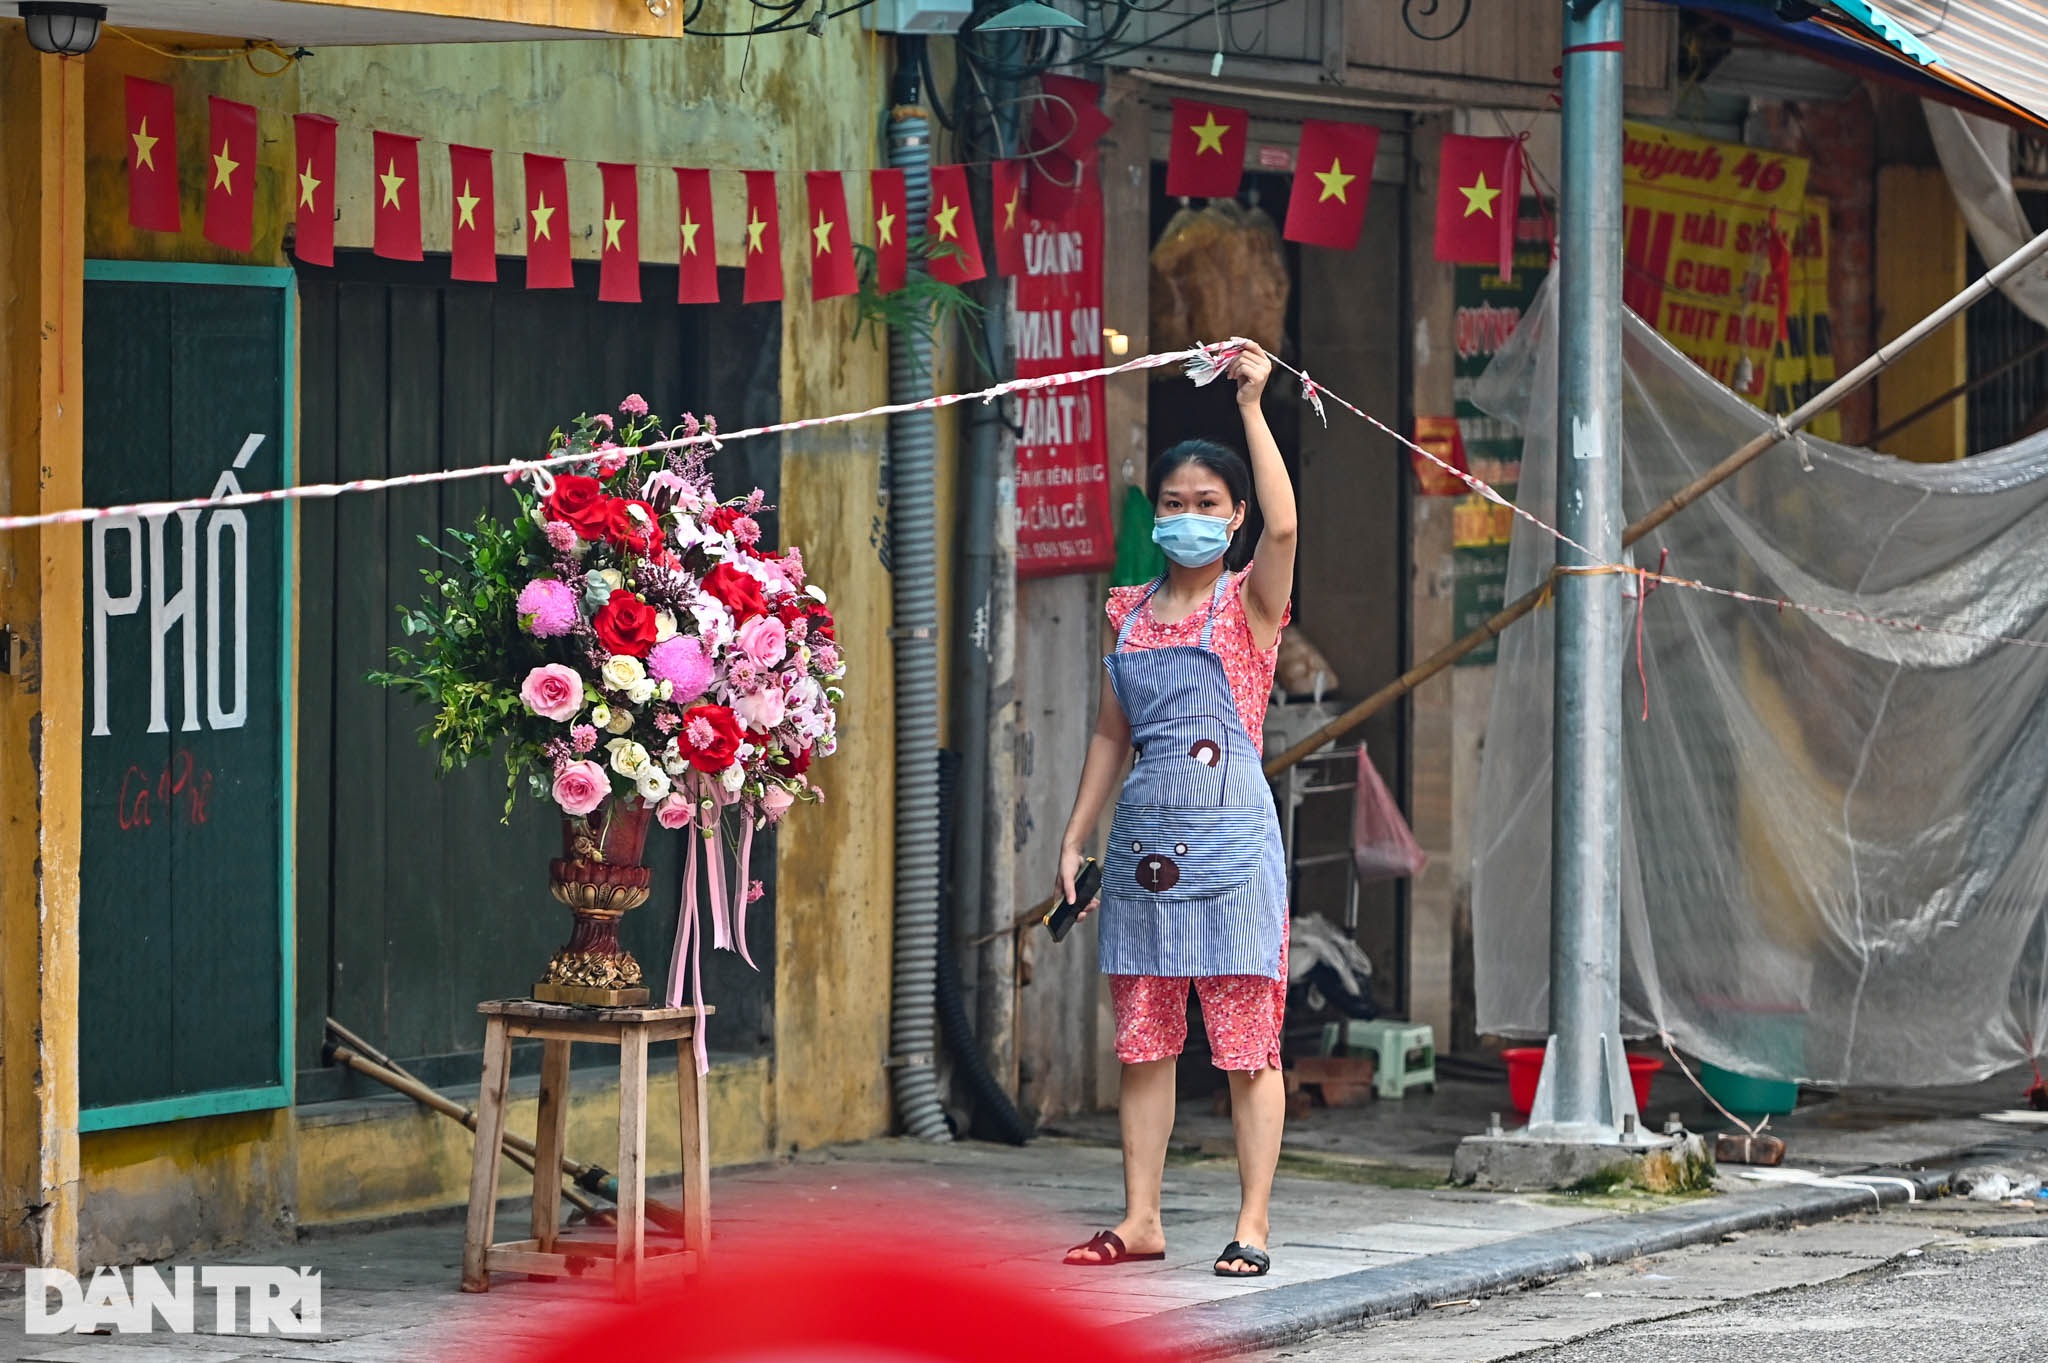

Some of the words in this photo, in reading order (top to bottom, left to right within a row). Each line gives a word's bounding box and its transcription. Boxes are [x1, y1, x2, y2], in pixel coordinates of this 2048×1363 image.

[1731, 152, 1787, 192] 46
[1674, 259, 1731, 296] CUA
[1667, 301, 1720, 343] THỊT
[91, 433, 266, 737] PHỐ
